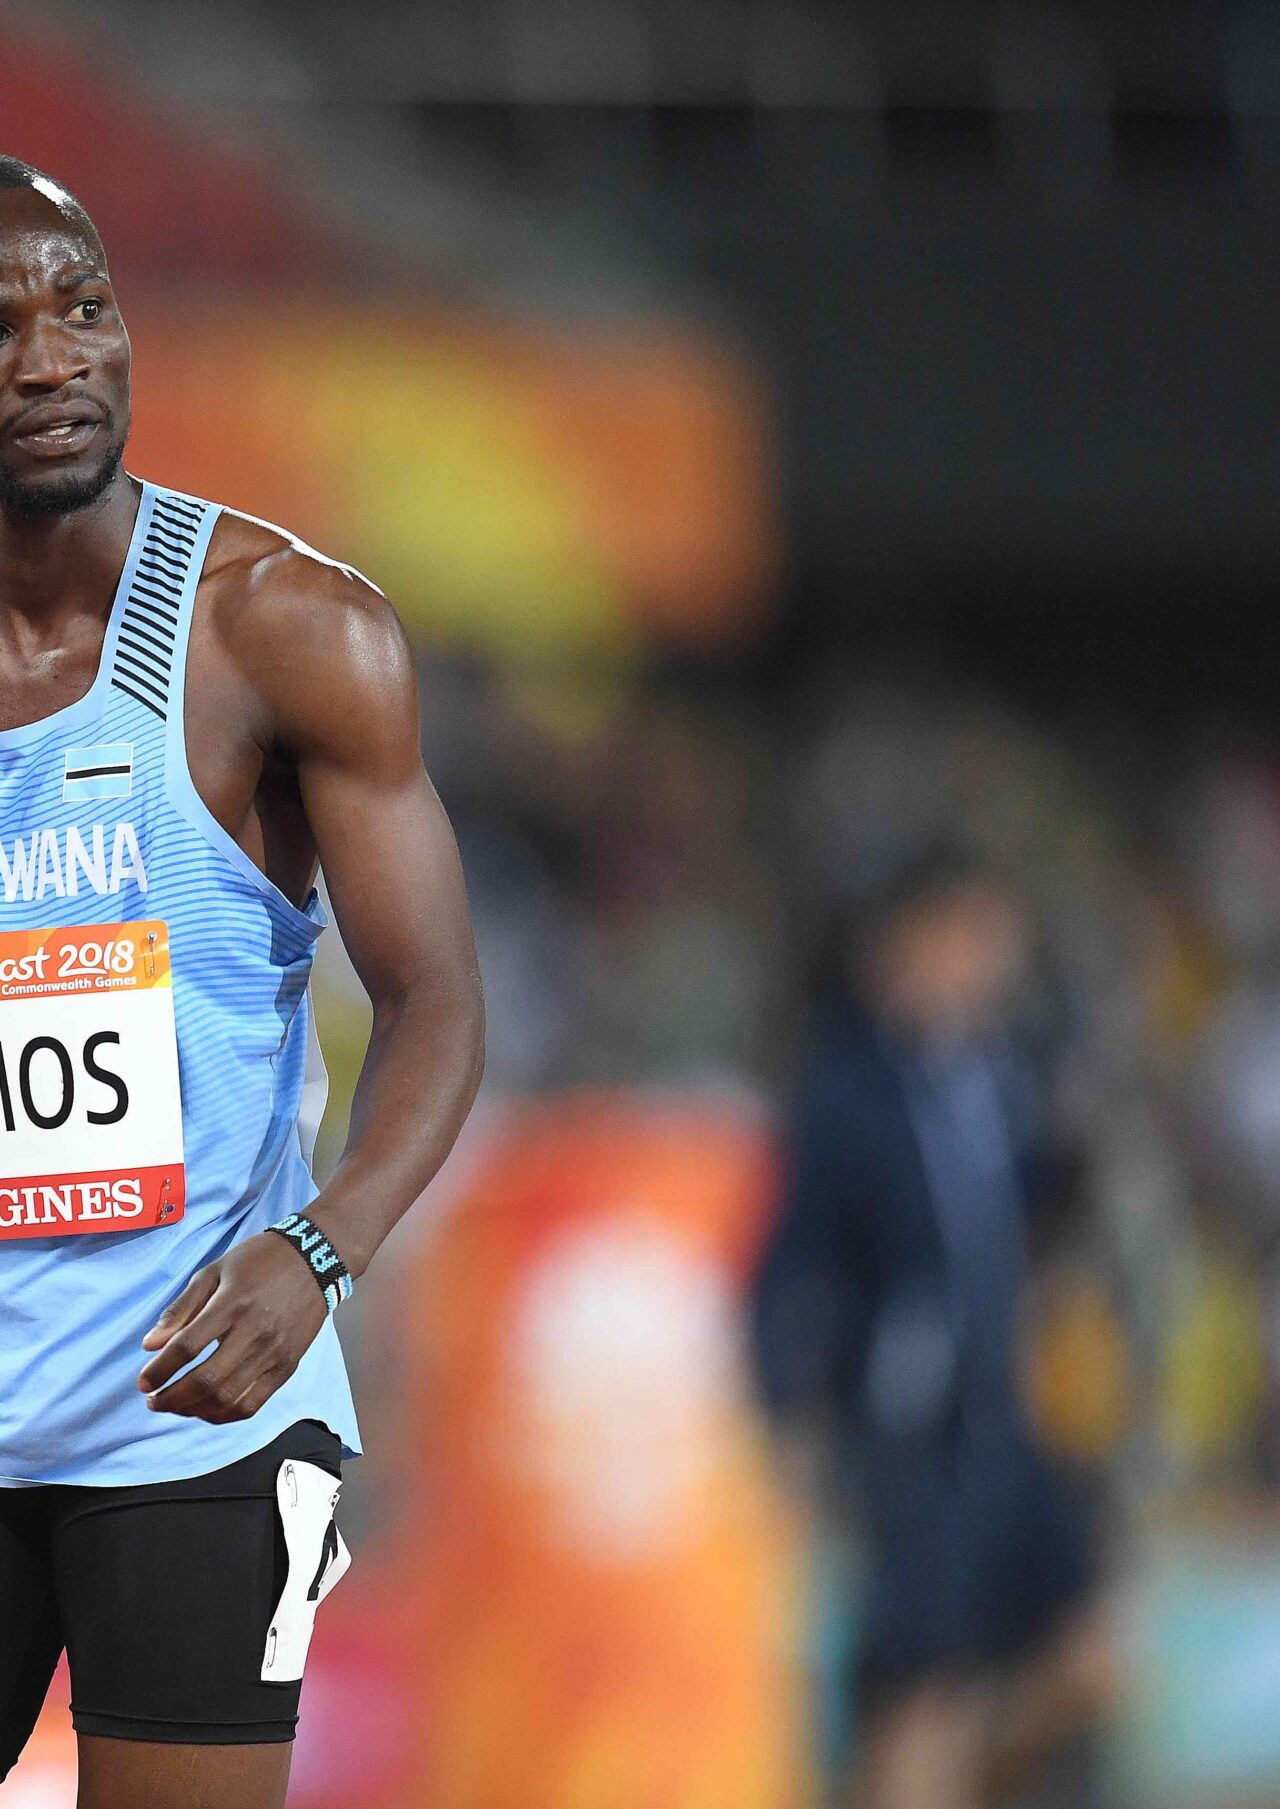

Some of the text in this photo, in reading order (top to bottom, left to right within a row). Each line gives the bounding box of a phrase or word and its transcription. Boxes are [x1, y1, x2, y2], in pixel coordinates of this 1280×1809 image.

[57, 939, 135, 978] 2018
[1, 977, 92, 996] Commonwealth
[95, 975, 138, 988] Games
